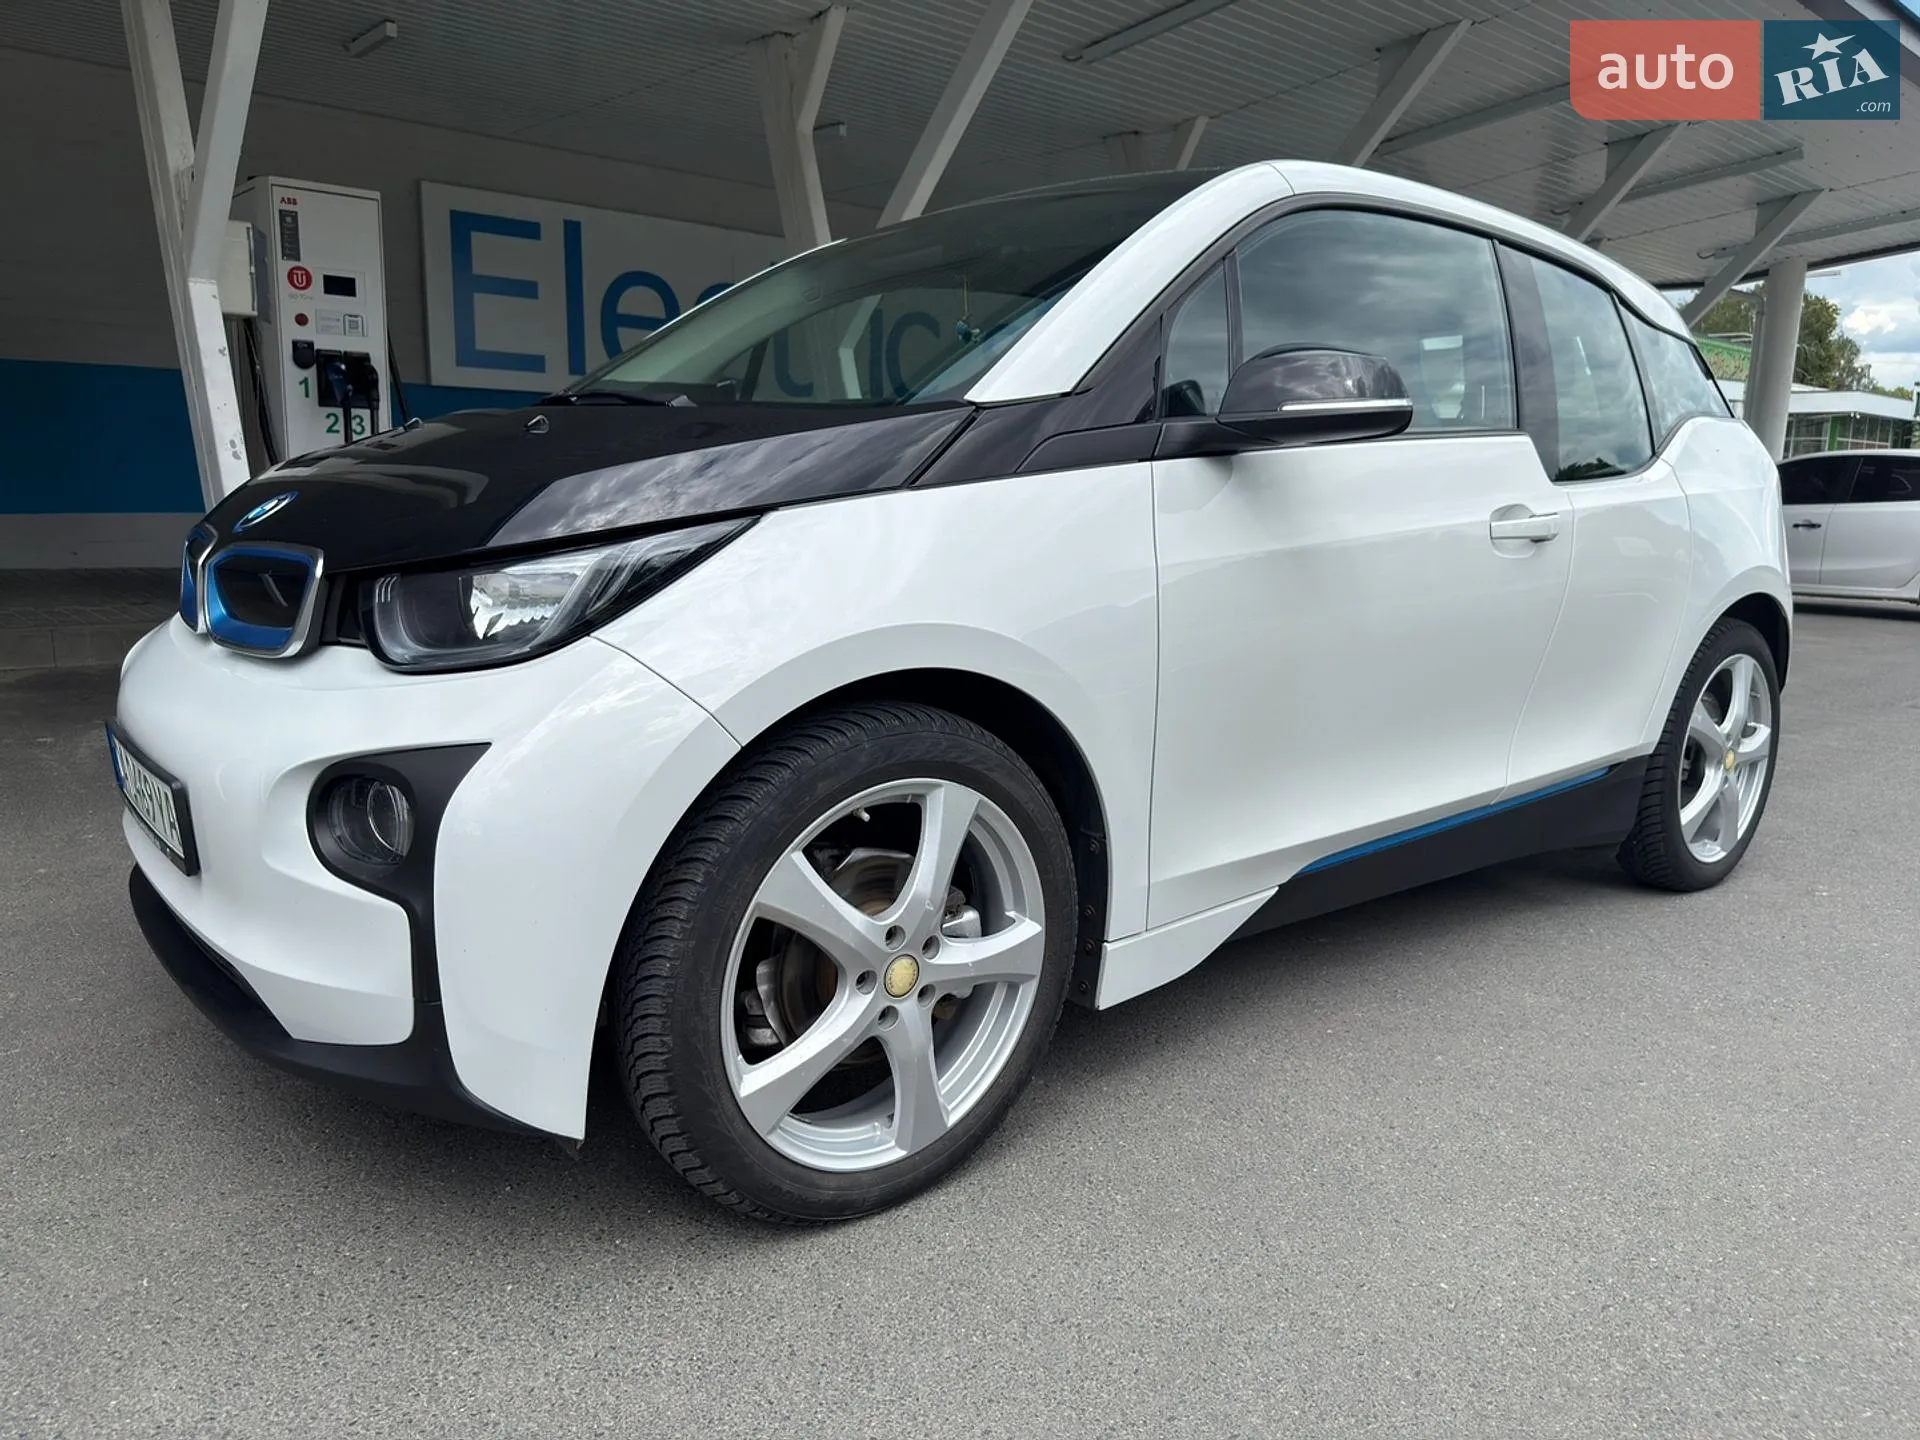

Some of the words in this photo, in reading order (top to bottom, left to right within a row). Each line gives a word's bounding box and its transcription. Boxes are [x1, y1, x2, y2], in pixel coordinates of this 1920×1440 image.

[299, 377, 309, 398] 1
[326, 413, 340, 433] 2
[351, 415, 366, 435] 3
